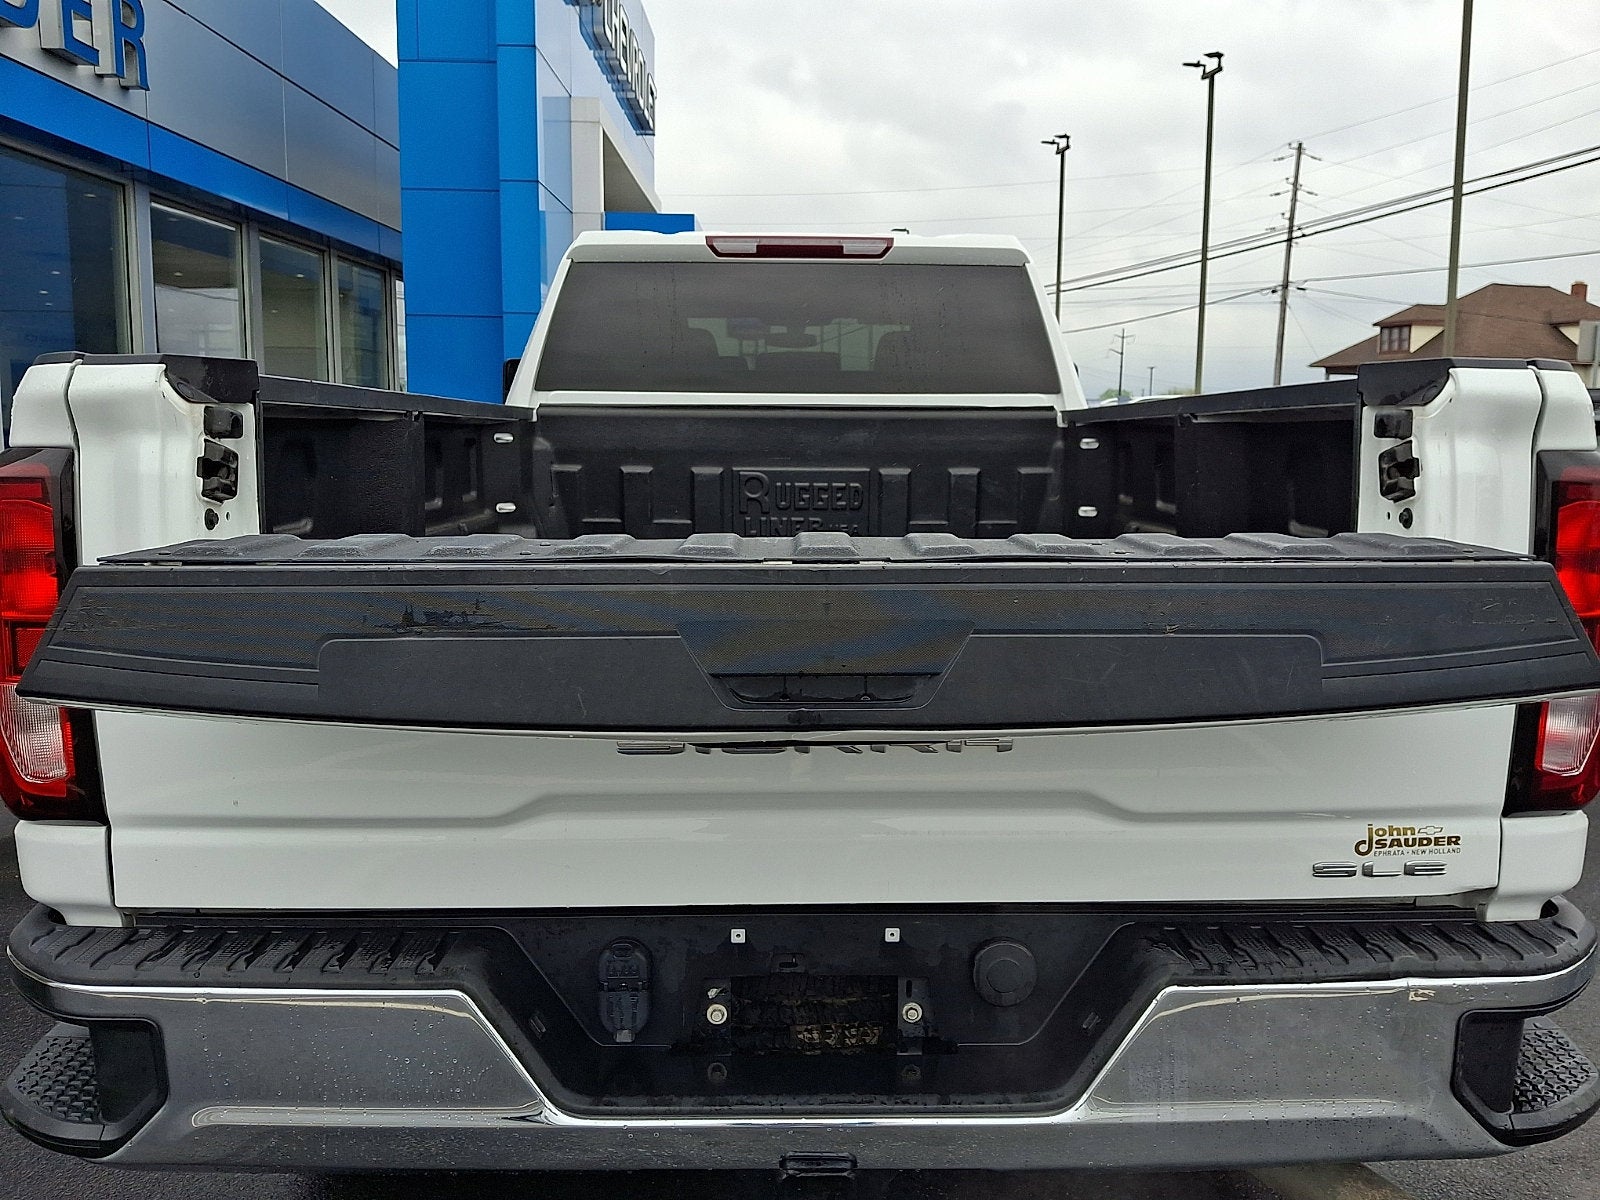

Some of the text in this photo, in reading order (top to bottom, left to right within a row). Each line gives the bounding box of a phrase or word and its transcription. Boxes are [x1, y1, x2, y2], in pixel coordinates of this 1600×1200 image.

[739, 471, 863, 514] RUGGED
[1354, 823, 1416, 857] john
[1374, 835, 1461, 850] SAUDER
[1312, 860, 1448, 877] SLE
